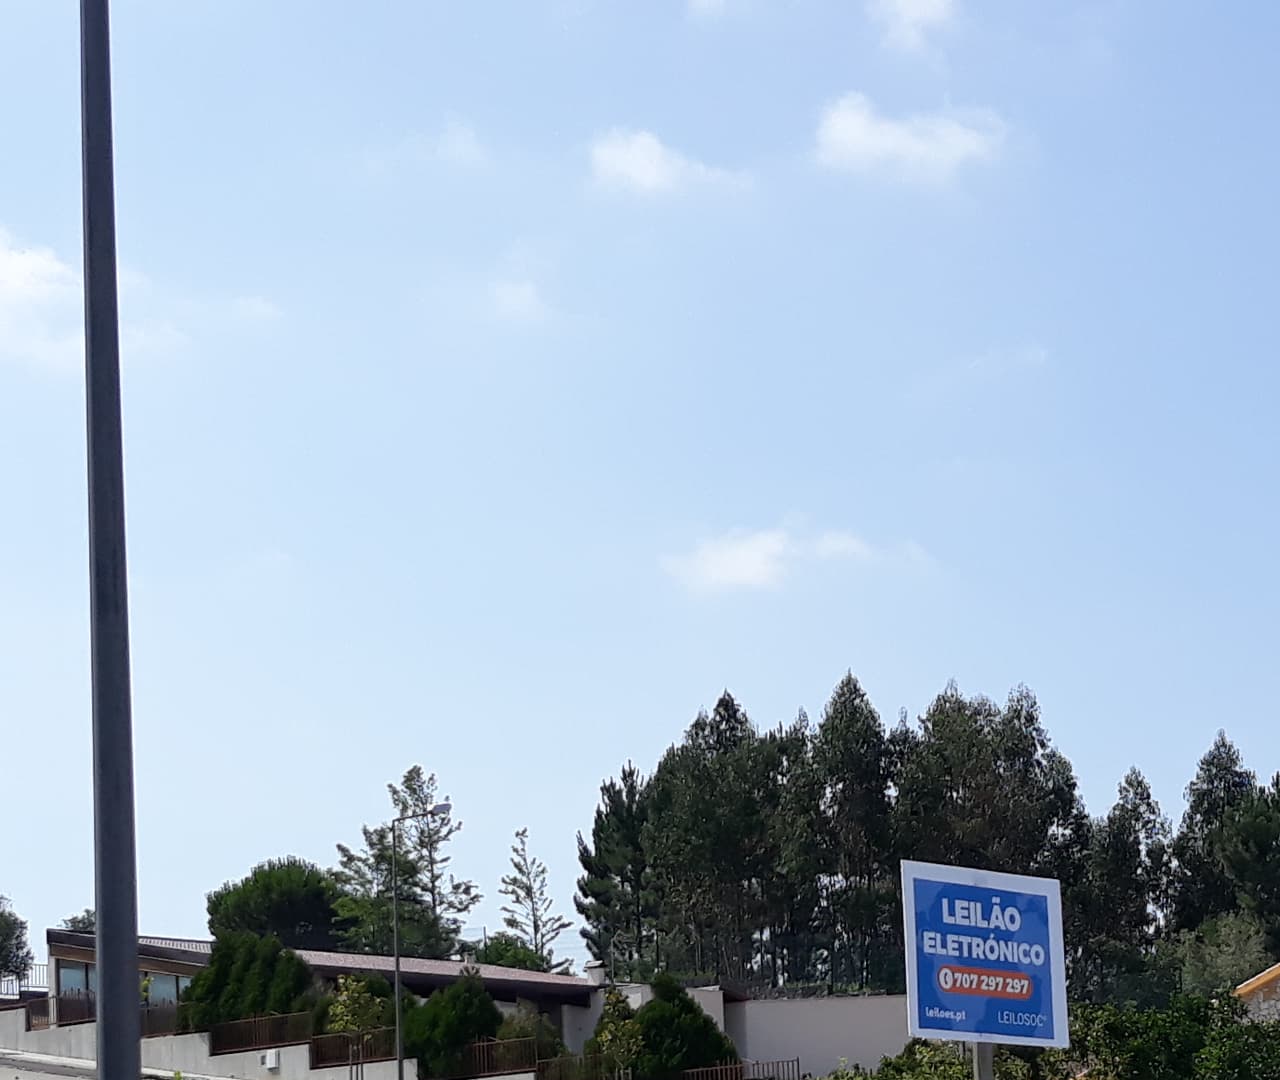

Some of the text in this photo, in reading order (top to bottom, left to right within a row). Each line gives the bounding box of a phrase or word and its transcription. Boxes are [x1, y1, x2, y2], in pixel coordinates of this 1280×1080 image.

[923, 931, 1045, 966] ELETRÓNICO
[954, 973, 1029, 994] 707 297 297
